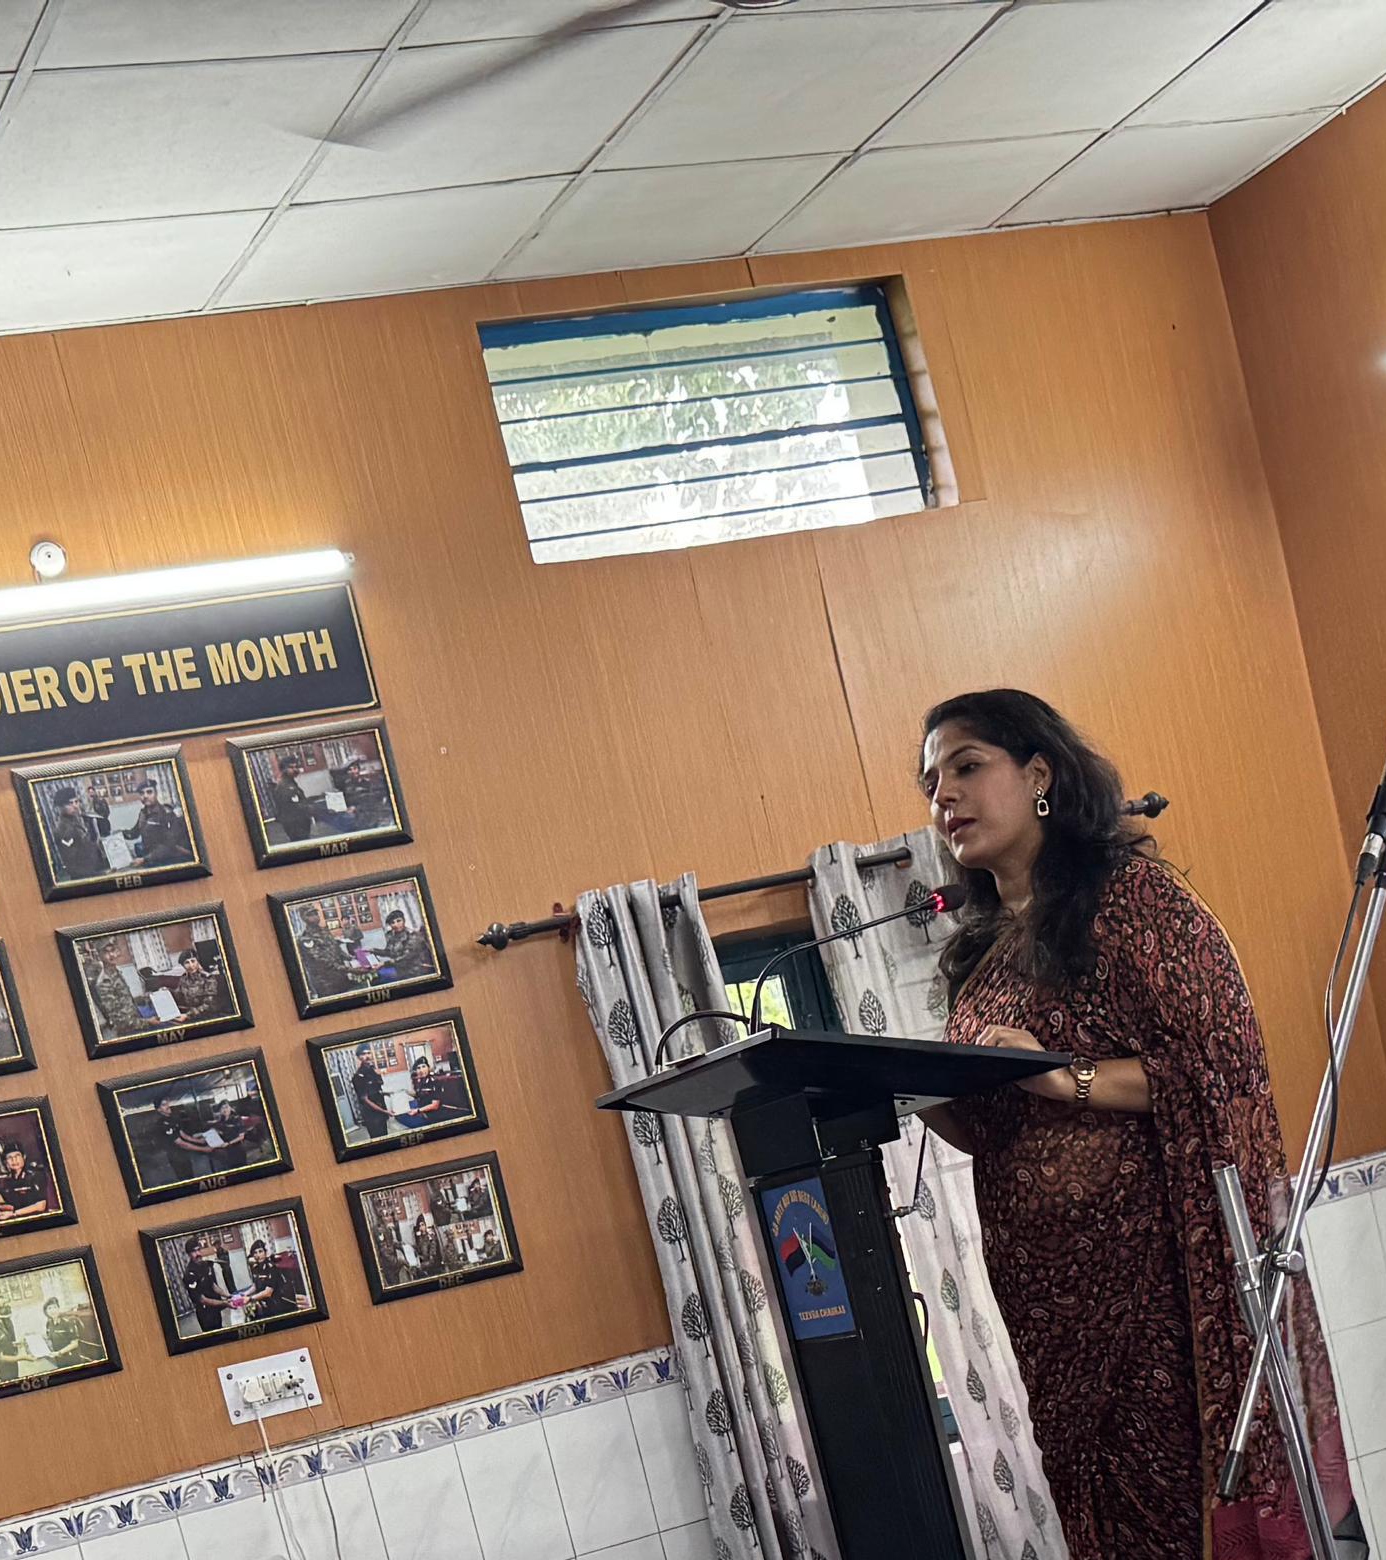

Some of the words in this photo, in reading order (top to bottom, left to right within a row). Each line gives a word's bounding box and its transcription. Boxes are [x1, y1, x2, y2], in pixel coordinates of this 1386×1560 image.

[66, 657, 114, 703] OF
[122, 647, 202, 696] THE
[205, 628, 338, 686] MONTH
[319, 841, 349, 857] MAR
[115, 875, 143, 889] FEB
[366, 988, 391, 1004] JUN
[156, 1029, 186, 1045] MAY
[400, 1132, 424, 1147] SEP
[198, 1176, 228, 1191] AUG
[237, 1323, 267, 1340] NOV
[20, 1375, 51, 1391] OCT
